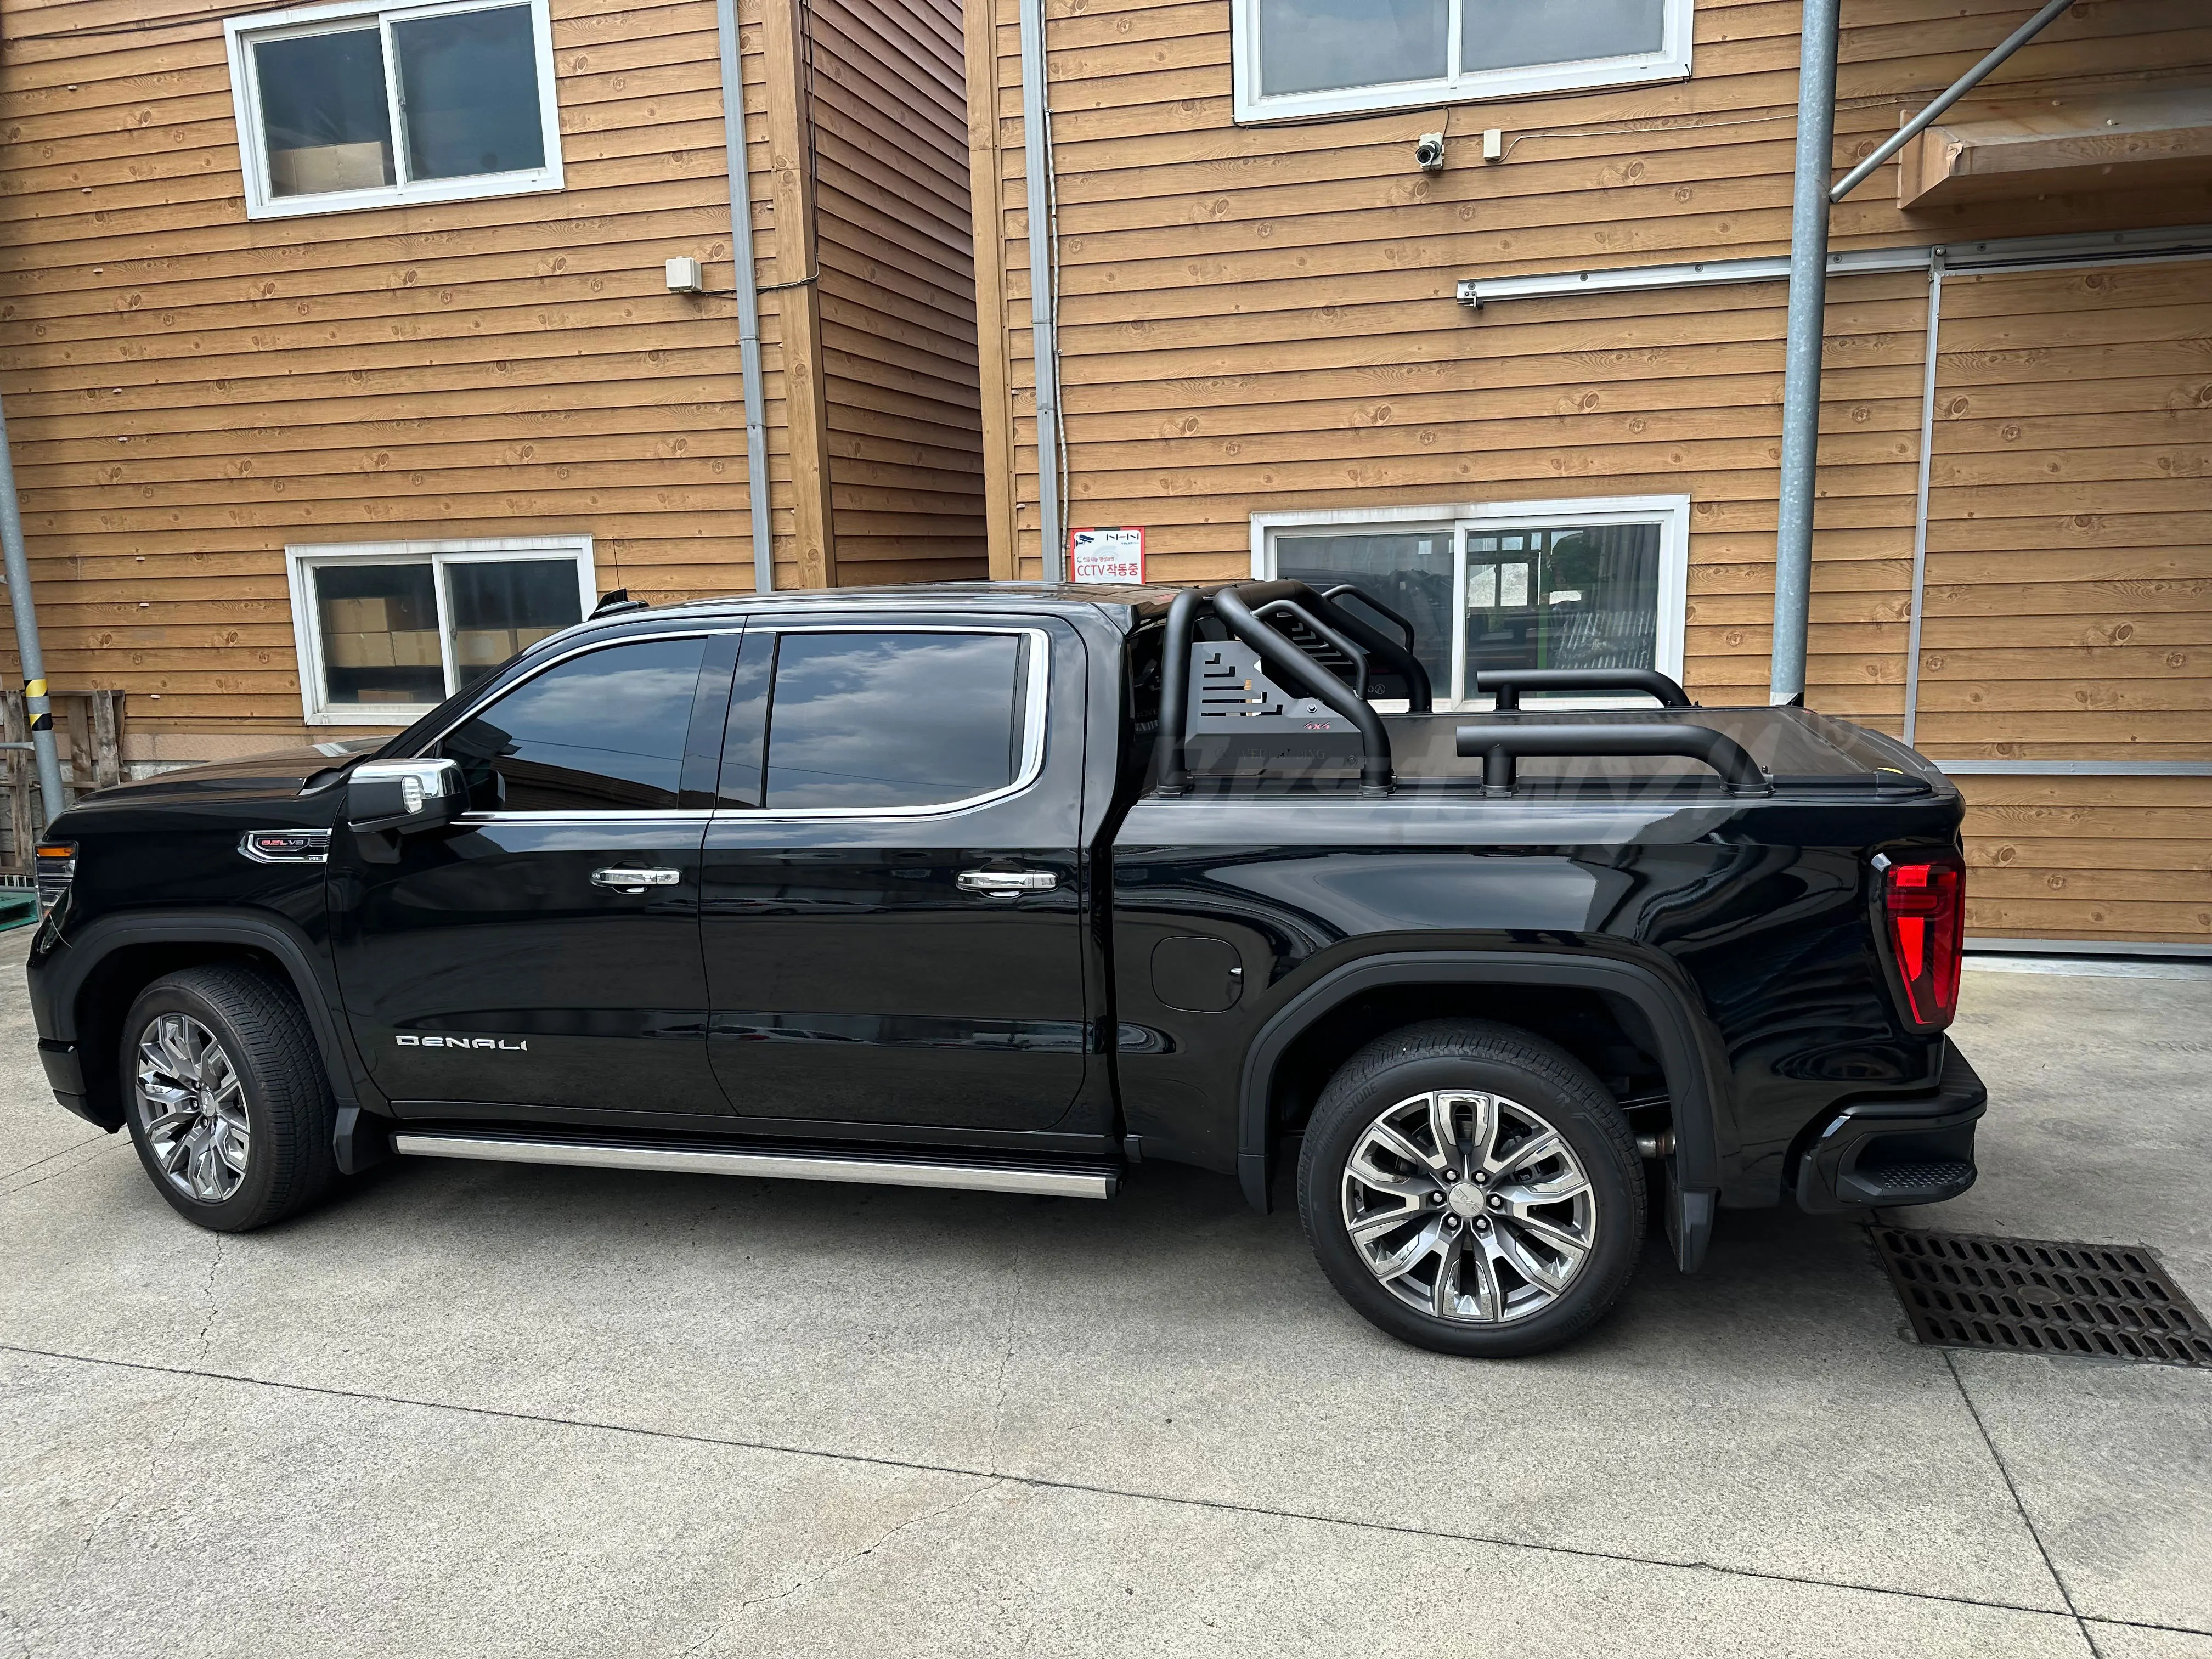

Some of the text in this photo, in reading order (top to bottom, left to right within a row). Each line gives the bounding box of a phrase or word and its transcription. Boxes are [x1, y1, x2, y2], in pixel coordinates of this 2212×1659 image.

[1077, 563, 1139, 577] CCTV 작동중
[1304, 721, 1330, 730] 4x4
[396, 1035, 528, 1051] DENALI
